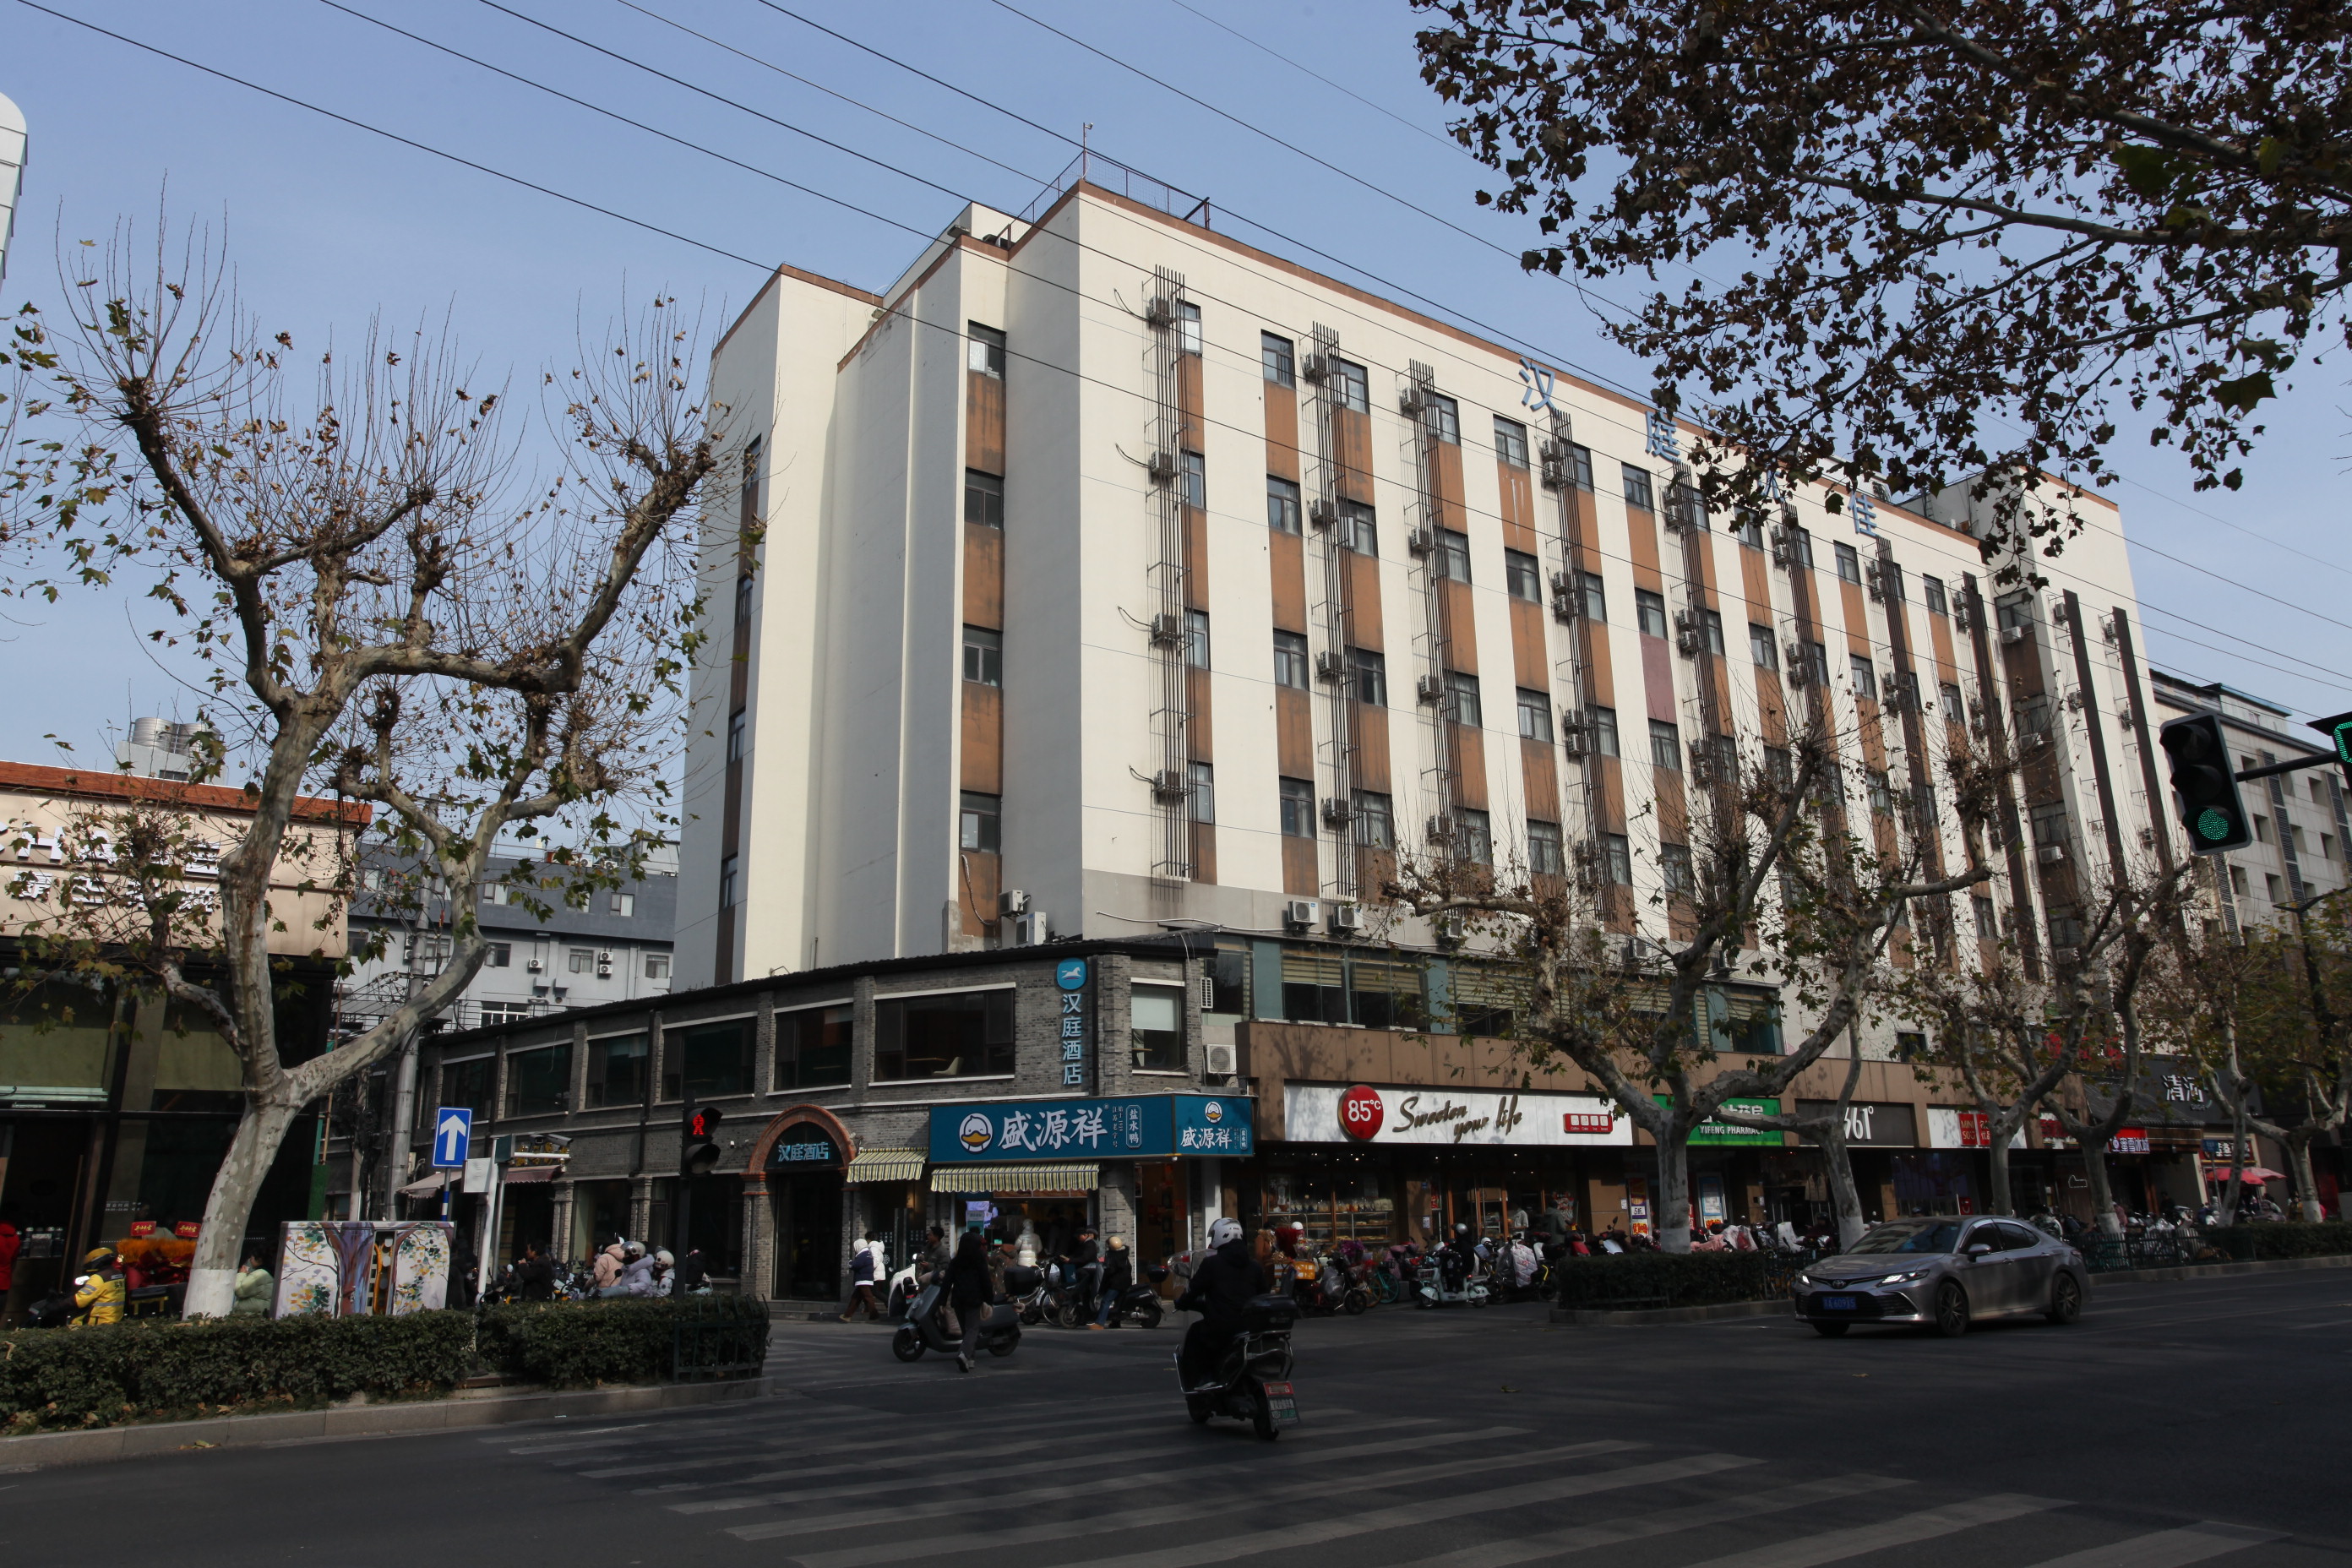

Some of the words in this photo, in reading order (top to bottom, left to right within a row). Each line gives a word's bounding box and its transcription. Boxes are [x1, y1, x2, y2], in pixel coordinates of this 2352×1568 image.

[1062, 994, 1081, 1085] 汉庭酒店
[1129, 1108, 1140, 1144] 盐水鸭
[1348, 1100, 1382, 1122] 85°C
[1392, 1096, 1468, 1133] Sweeten
[1453, 1115, 1489, 1144] your
[1495, 1094, 1522, 1136] life
[998, 1106, 1108, 1152] 盛源祥
[1180, 1126, 1233, 1150] 盛源祥
[1700, 1126, 1724, 1135] YIFENG
[1727, 1126, 1764, 1135] PHARMAC
[778, 1142, 829, 1162] 汉庭酒店
